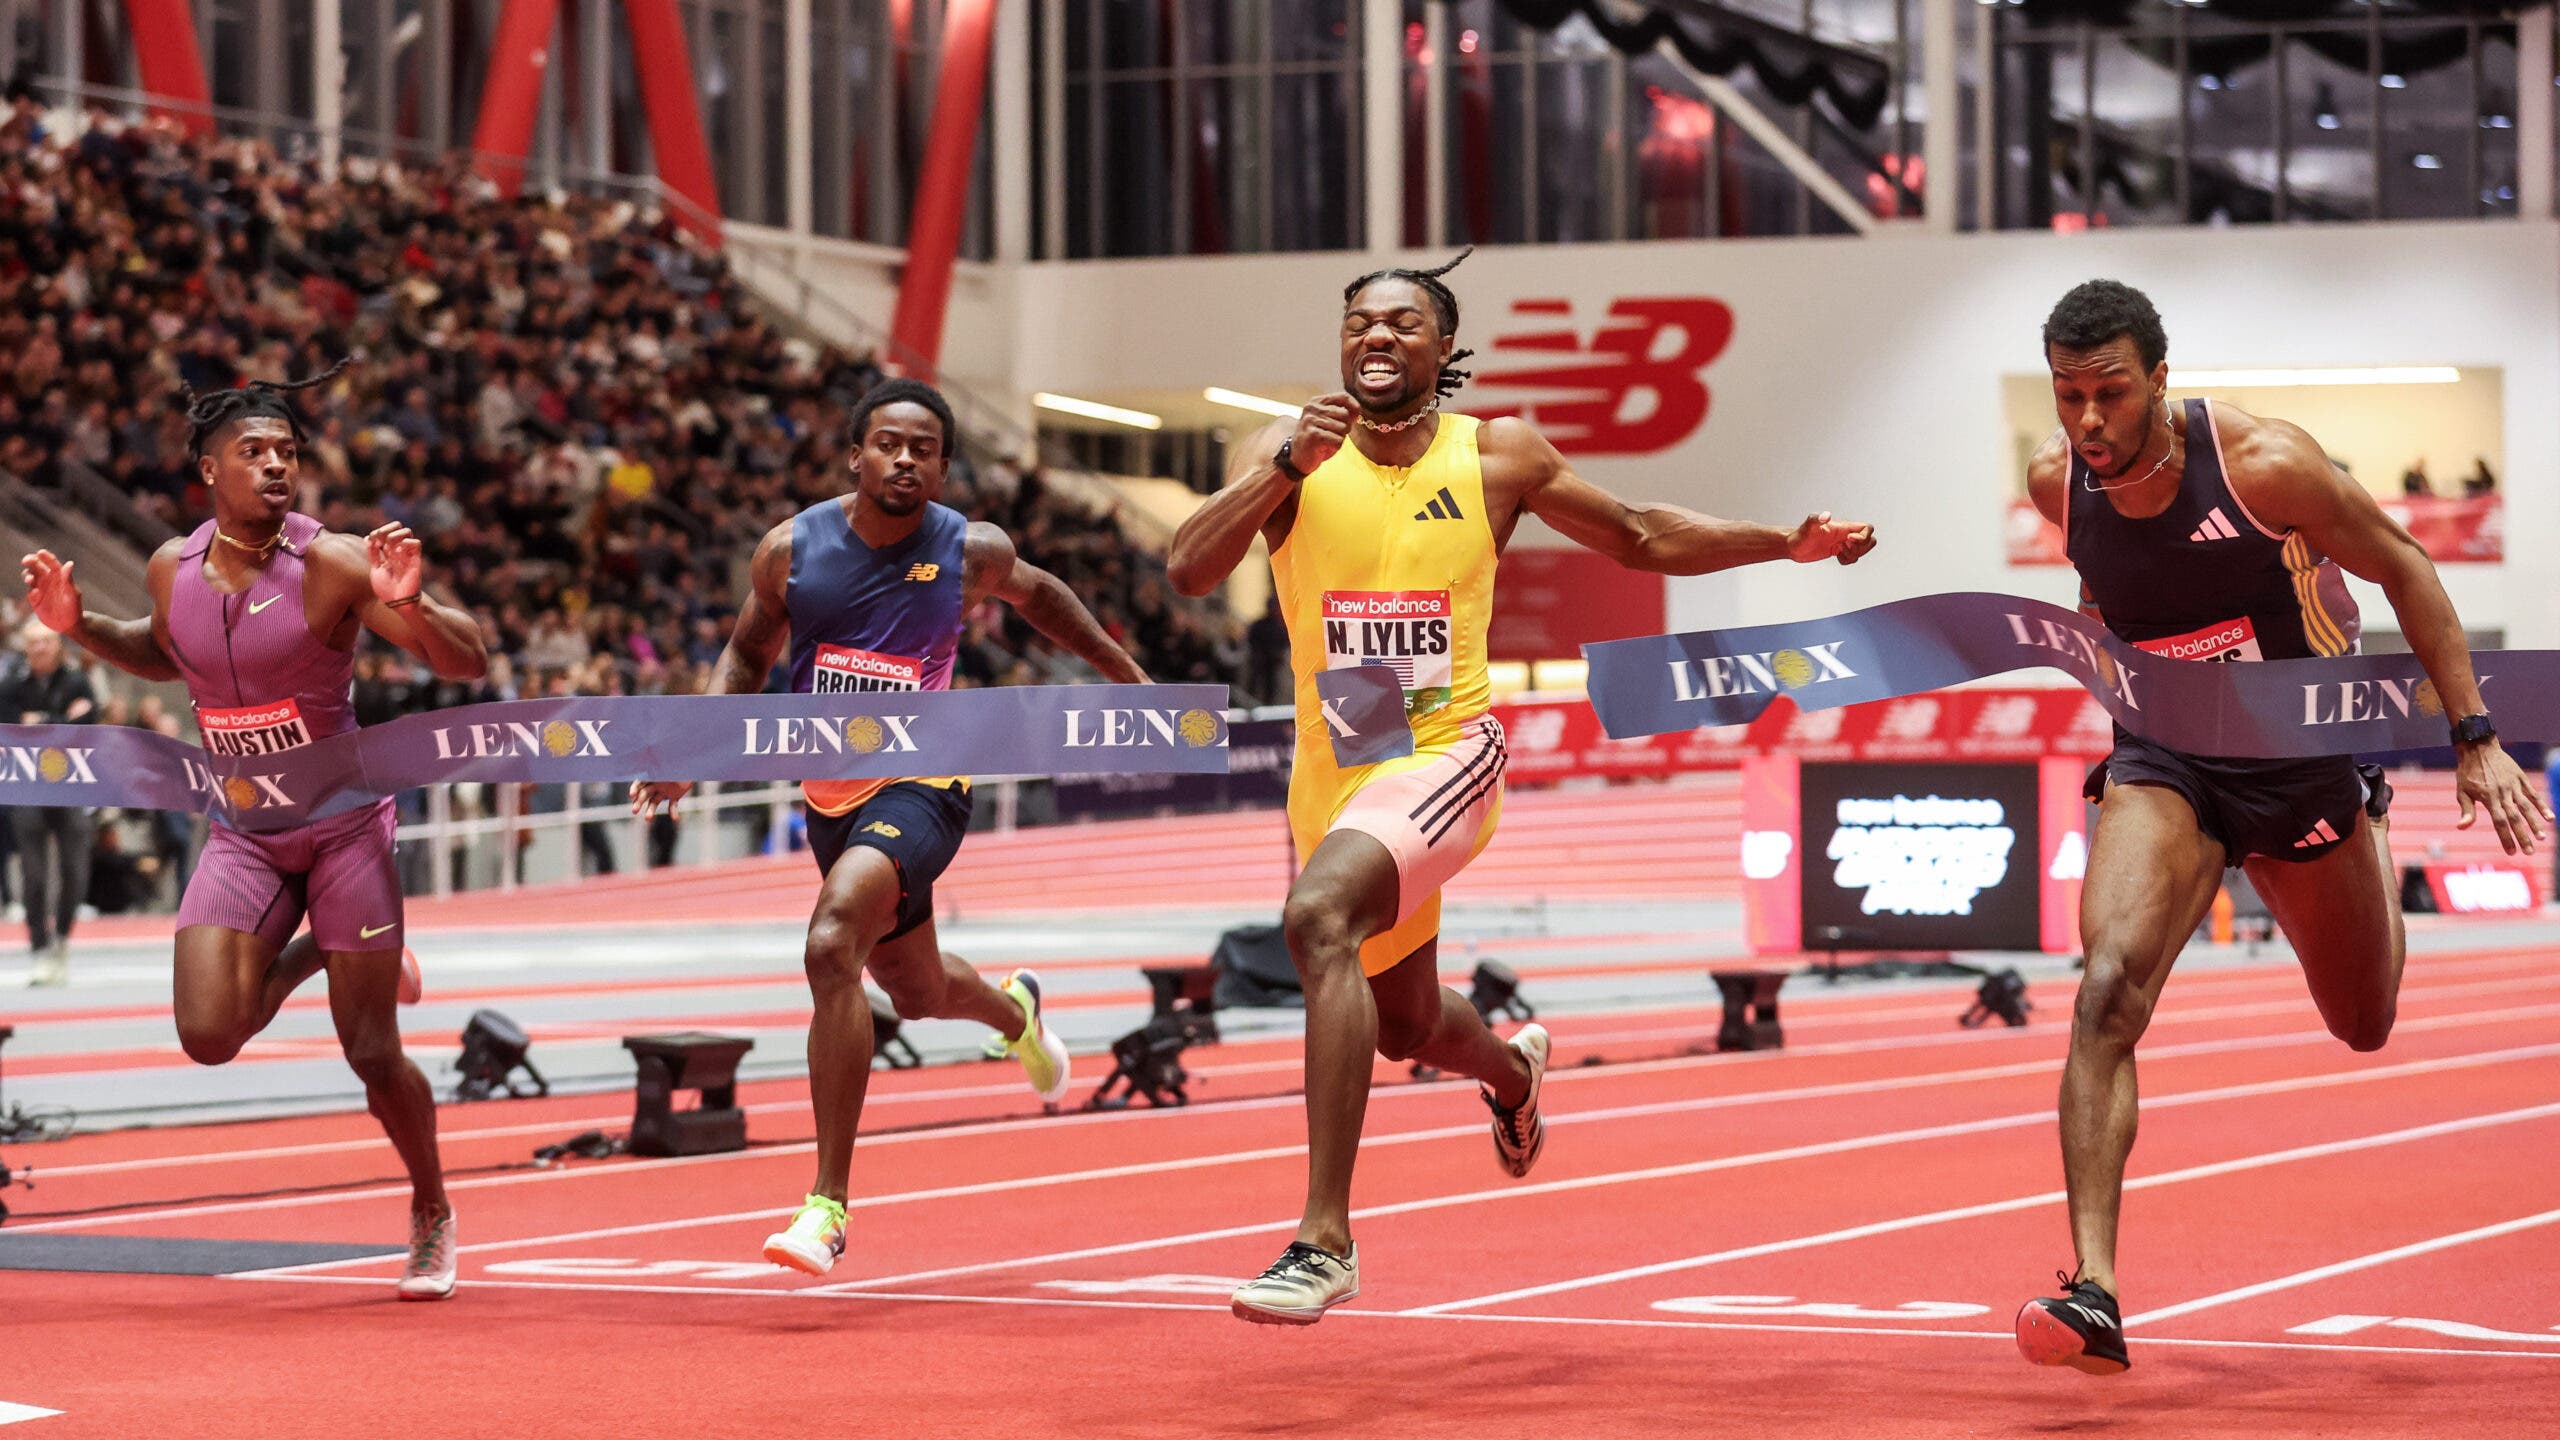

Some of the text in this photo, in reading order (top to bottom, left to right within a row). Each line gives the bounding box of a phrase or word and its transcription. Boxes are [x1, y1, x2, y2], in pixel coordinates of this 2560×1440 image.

[1330, 598, 1441, 614] new balance
[1327, 619, 1447, 657] N. LYLES
[2171, 626, 2244, 659] balance
[821, 652, 913, 677] new balance
[1667, 640, 1860, 702] LENOX
[205, 707, 291, 726] new balance
[211, 720, 304, 757] AUSTIN
[432, 720, 612, 761] LENOX
[742, 715, 920, 756] LENOX
